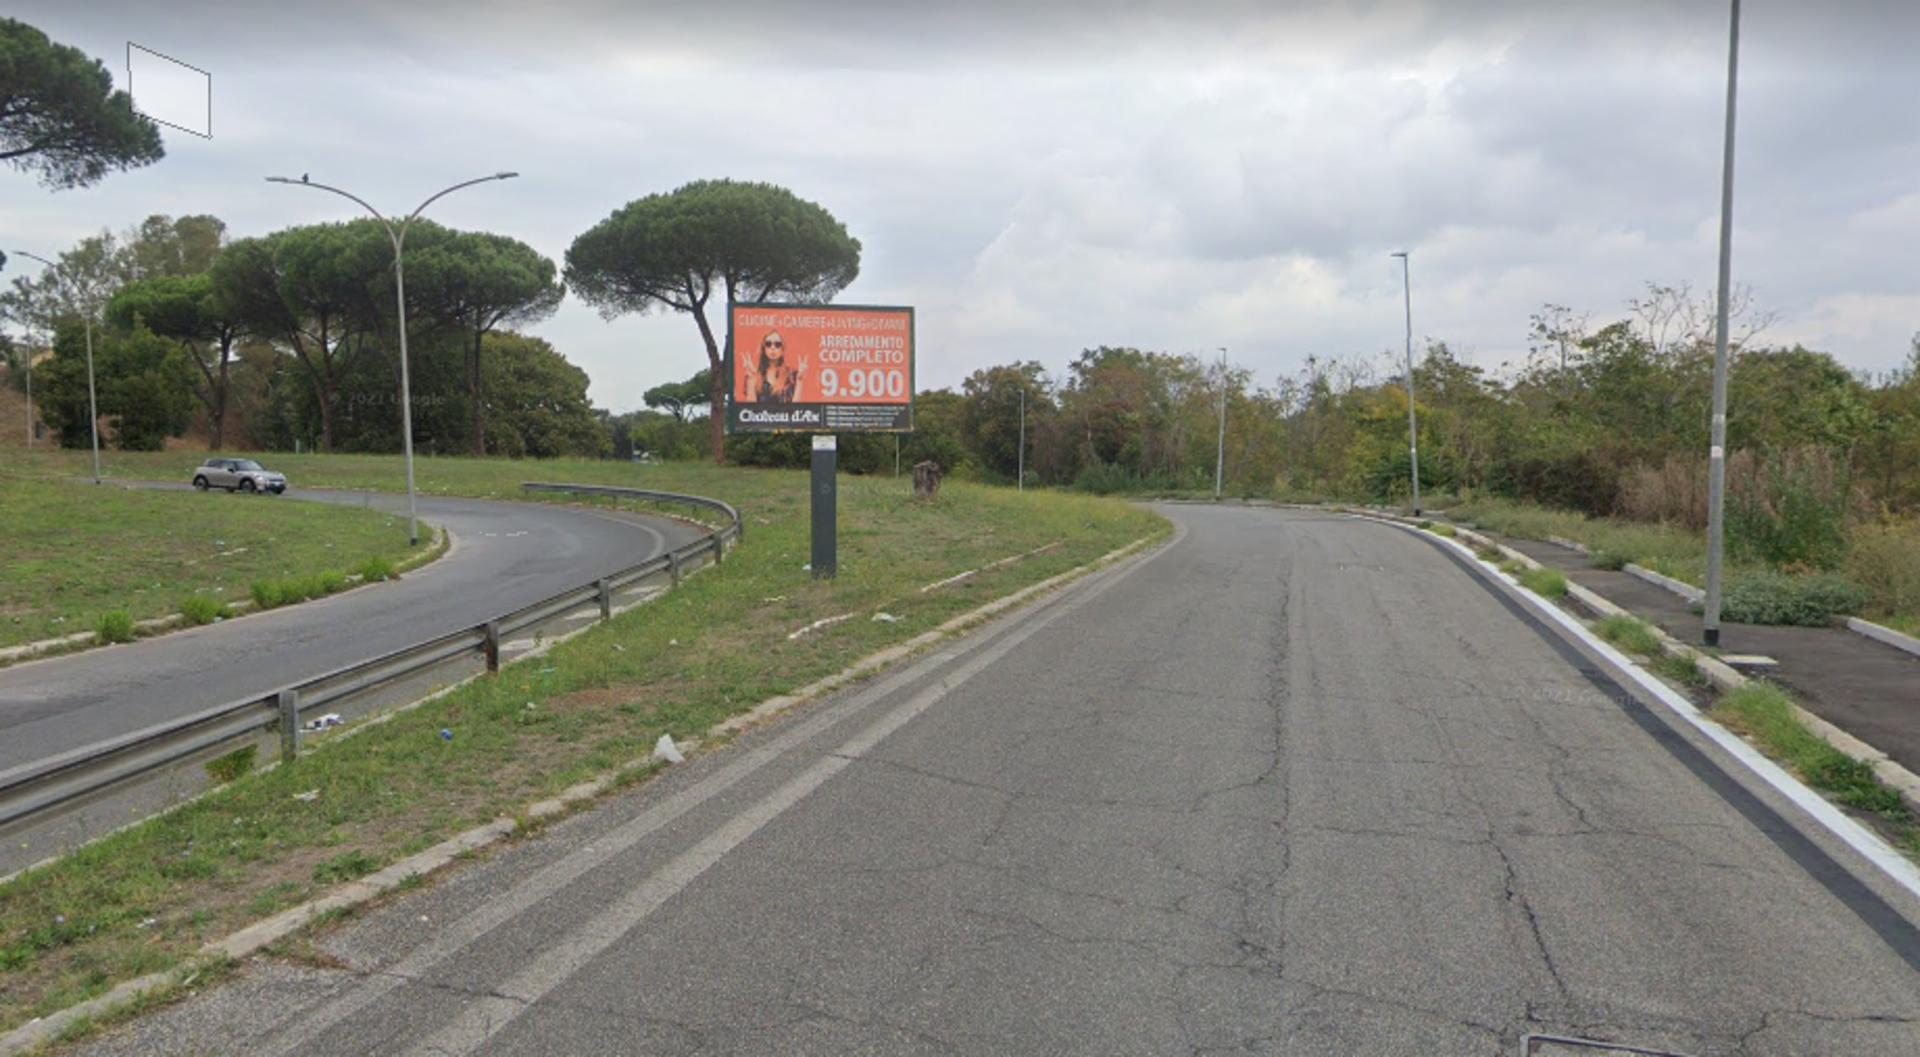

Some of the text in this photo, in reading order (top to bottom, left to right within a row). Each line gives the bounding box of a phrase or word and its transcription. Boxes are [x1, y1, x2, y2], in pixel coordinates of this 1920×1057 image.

[819, 335, 903, 349] ARREDAMENTO
[819, 349, 904, 364] COMPLETO
[820, 368, 904, 398] 9.900
